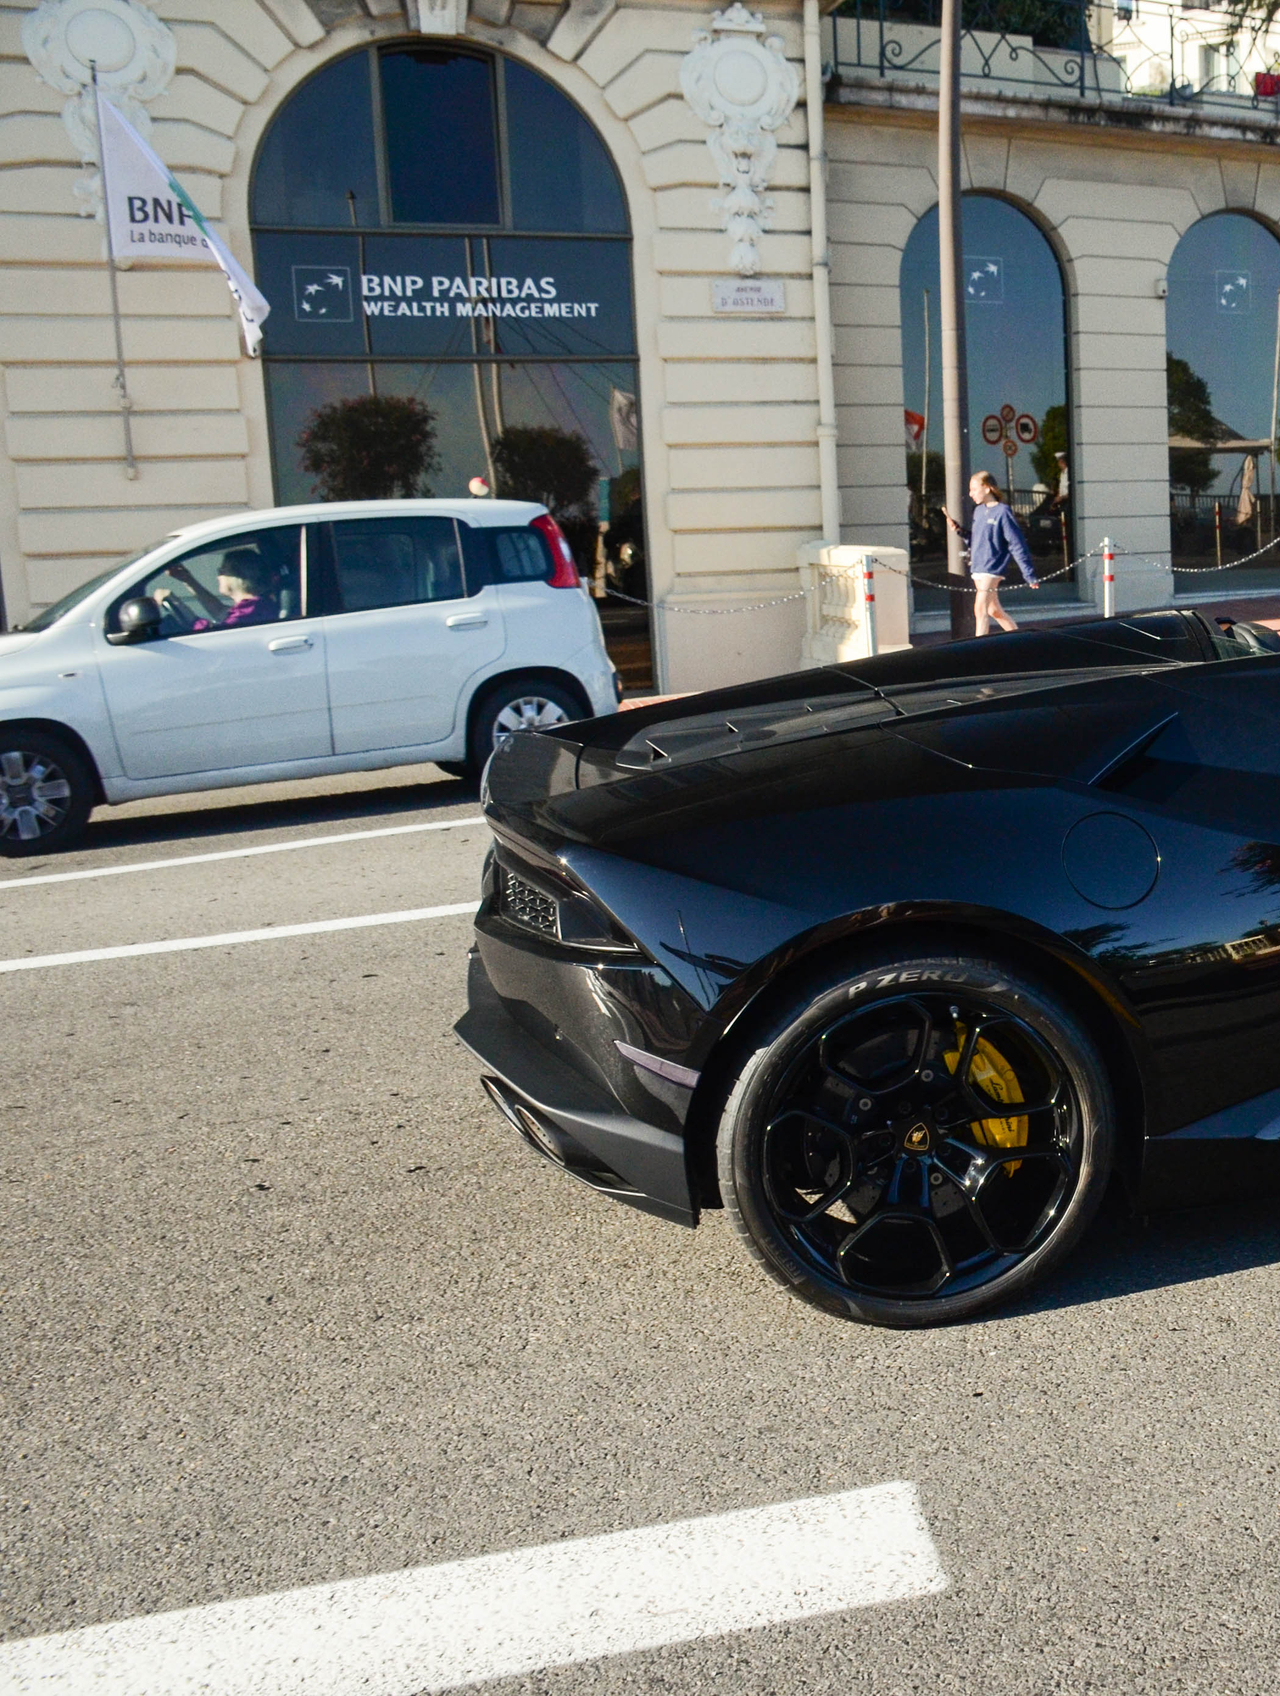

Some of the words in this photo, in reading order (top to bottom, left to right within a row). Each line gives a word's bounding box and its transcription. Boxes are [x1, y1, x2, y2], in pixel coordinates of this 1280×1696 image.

[130, 230, 145, 243] La
[150, 230, 197, 248] banque
[361, 274, 424, 297] BNP
[432, 276, 557, 299] PARIBAS
[363, 301, 450, 317] WEALTH
[456, 302, 599, 318] MANAGEMENT
[848, 981, 868, 1000] P
[875, 969, 969, 989] ZERO
